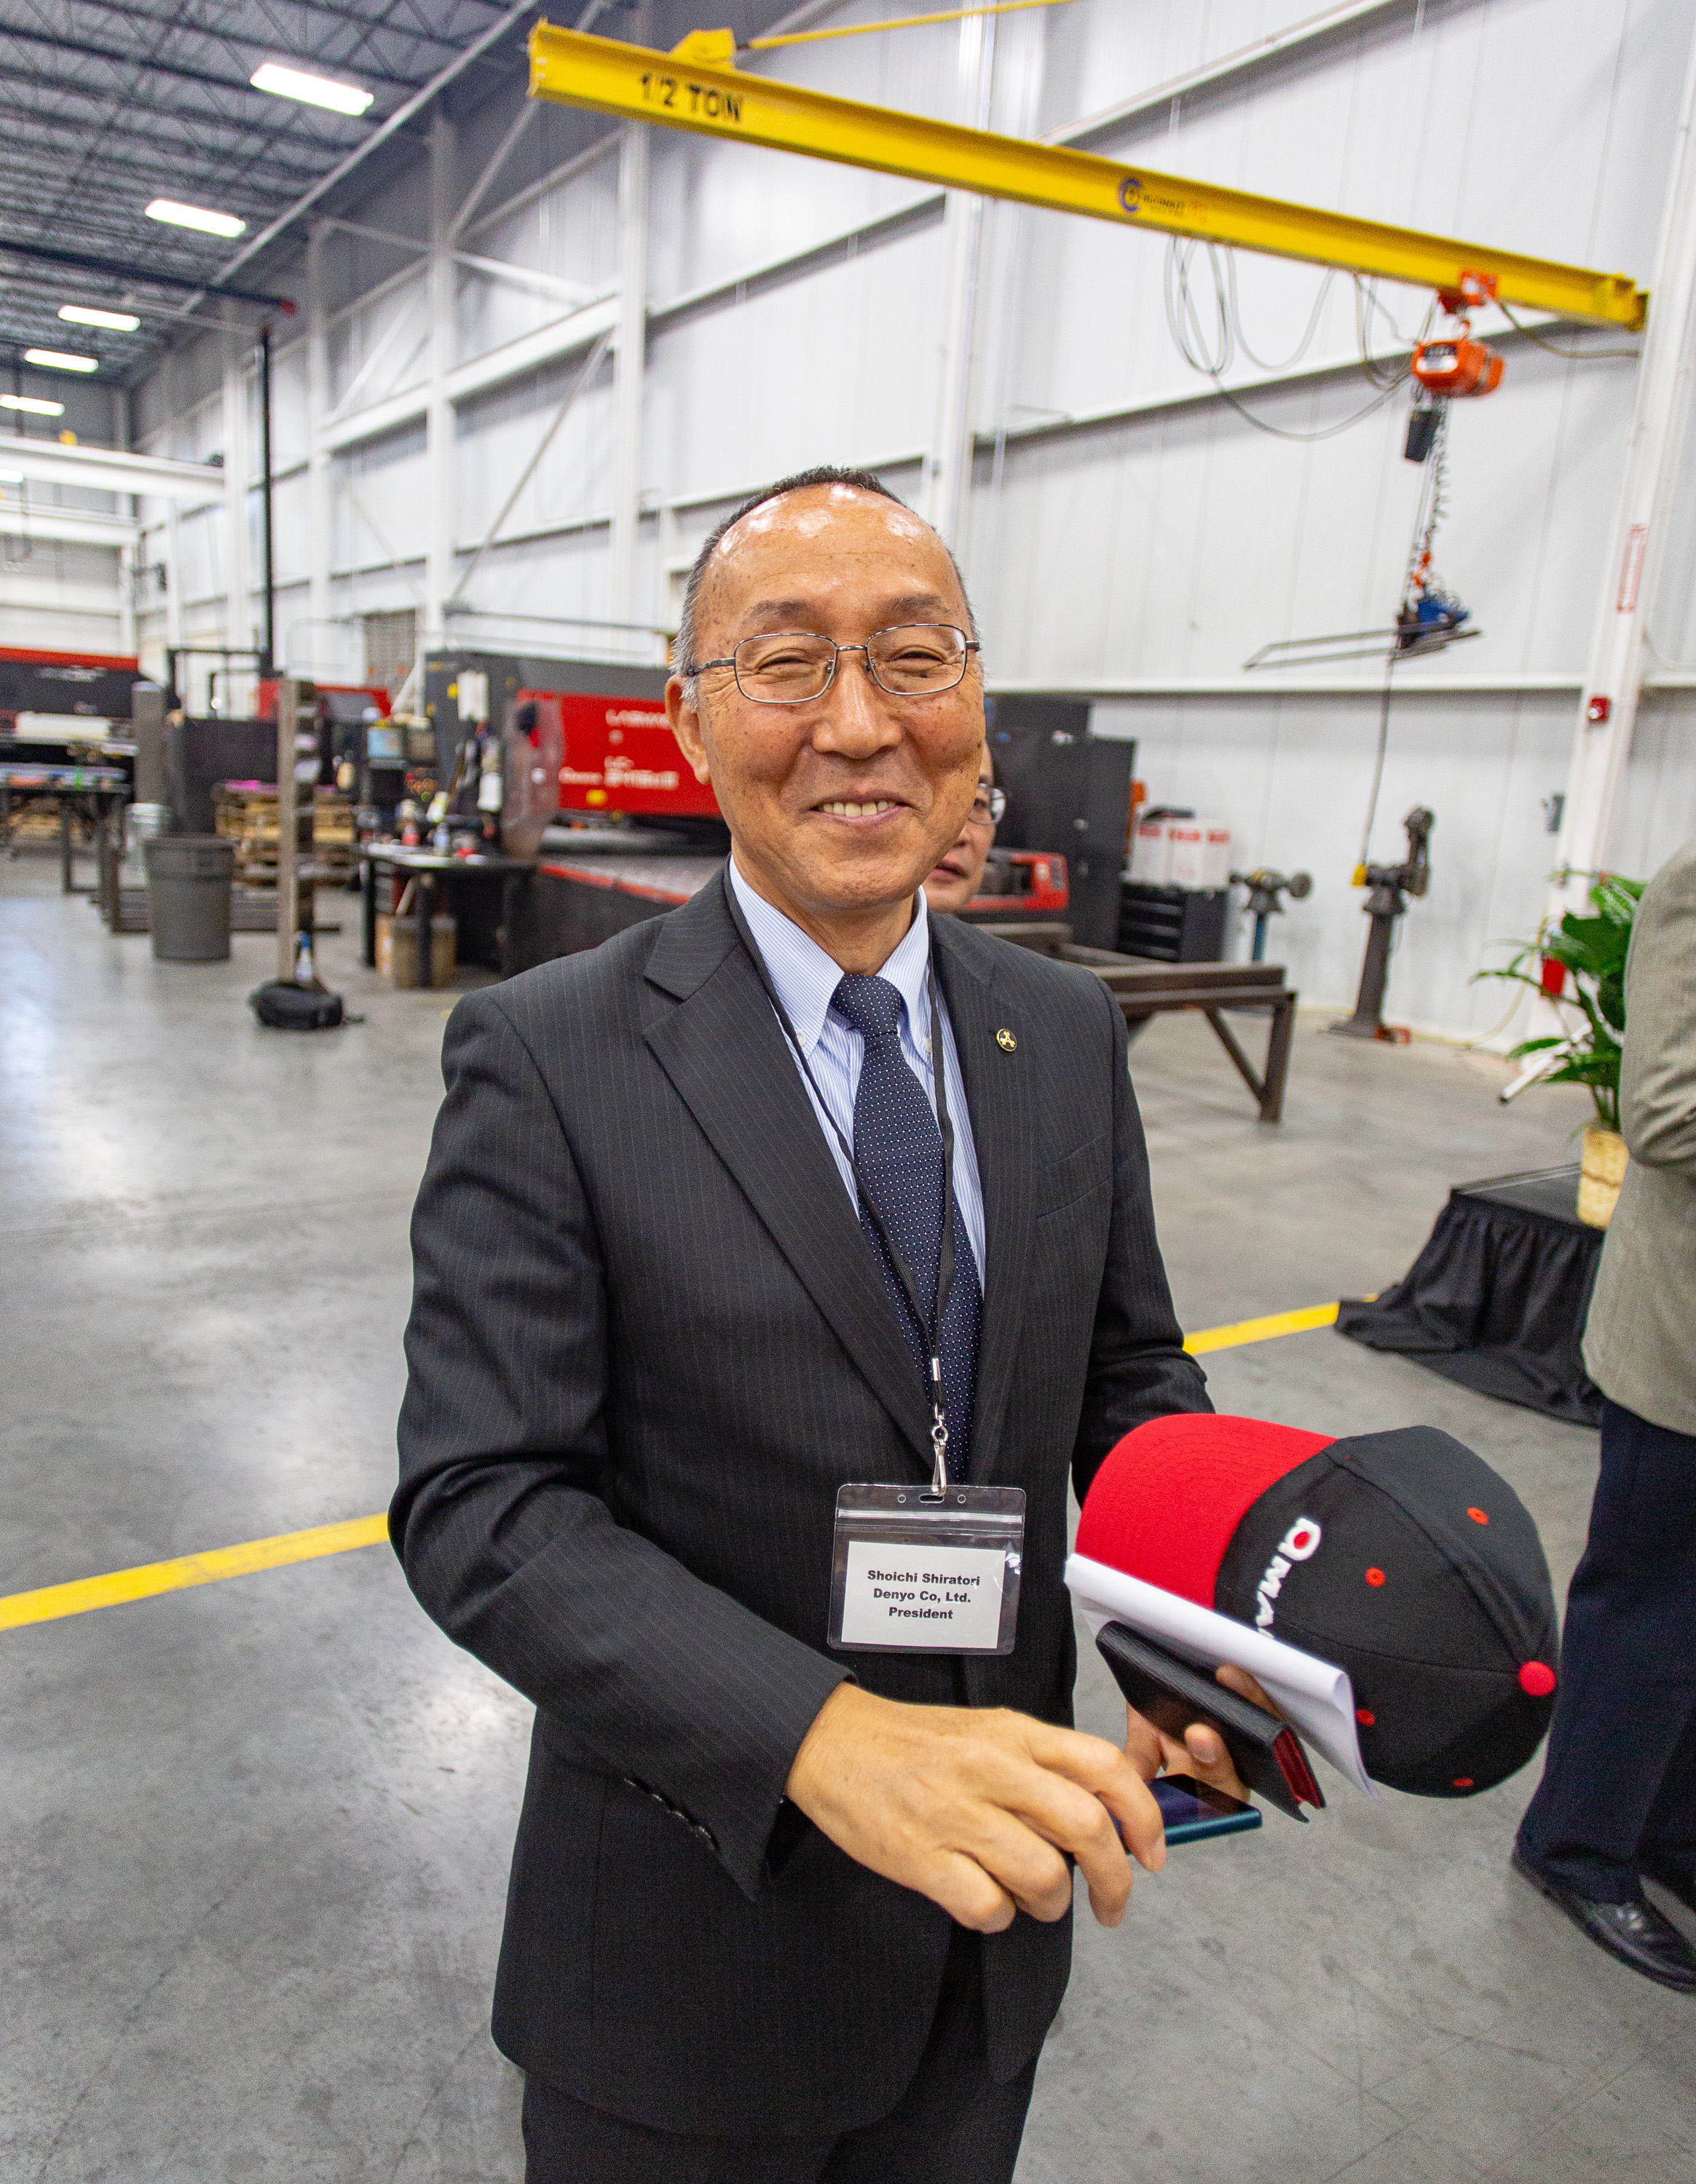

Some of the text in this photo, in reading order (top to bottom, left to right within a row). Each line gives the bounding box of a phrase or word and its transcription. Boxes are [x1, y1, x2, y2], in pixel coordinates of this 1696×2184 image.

[688, 84, 744, 122] TON
[867, 1570, 980, 1586] Shoichi Shiratori
[873, 1588, 971, 1603] Denyo Co, Ltd.
[888, 1607, 953, 1619] President
